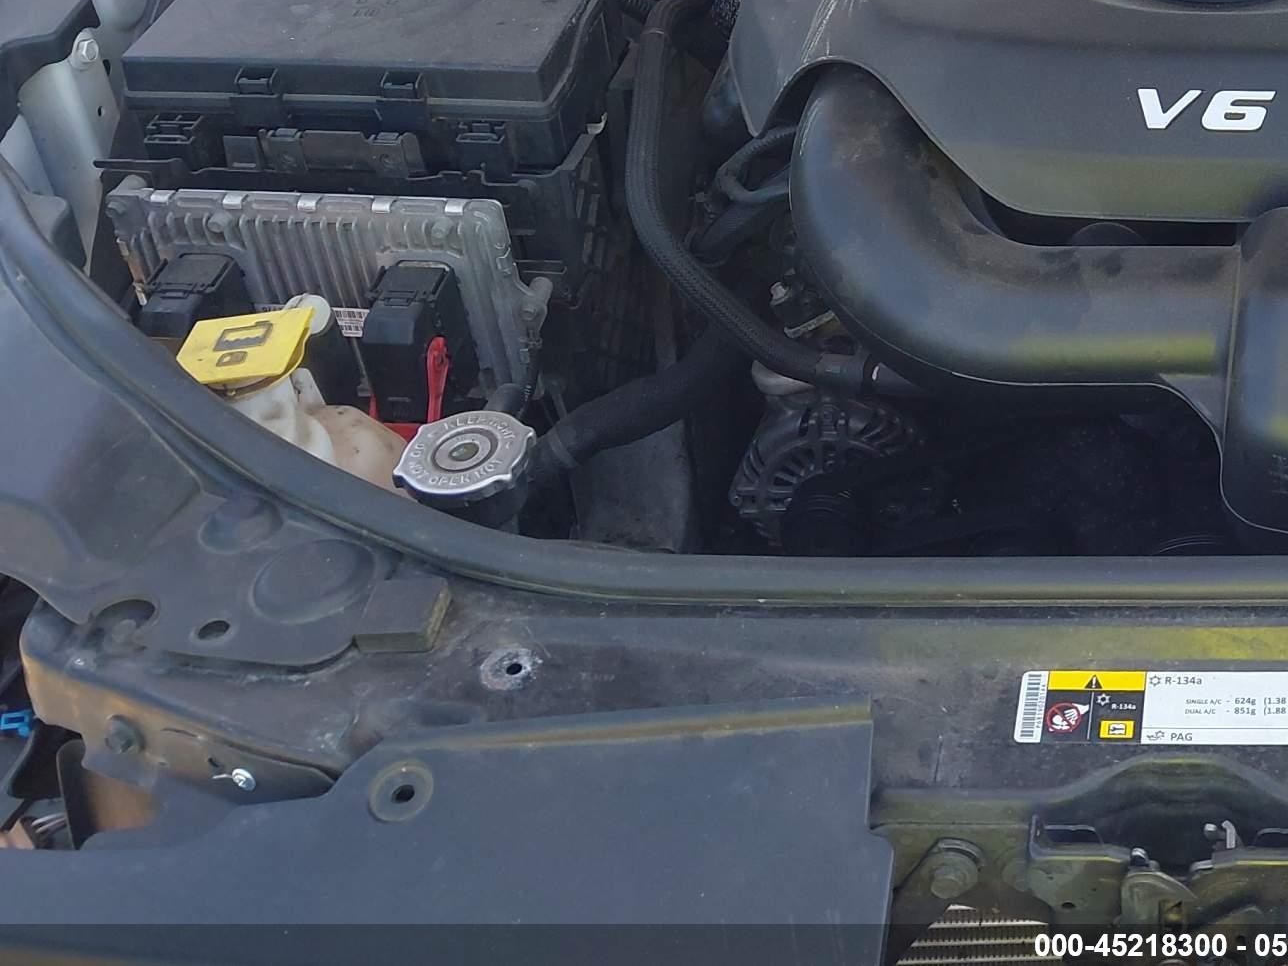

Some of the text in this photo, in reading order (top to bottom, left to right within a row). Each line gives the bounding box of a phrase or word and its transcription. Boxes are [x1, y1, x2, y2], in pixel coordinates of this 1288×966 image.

[1137, 88, 1277, 131] V6
[1164, 675, 1203, 685] R-134a
[1210, 698, 1222, 706] A/C
[1234, 697, 1257, 706] 624g
[1263, 696, 1287, 706] (1.38
[1111, 703, 1137, 711] R-134a
[1233, 706, 1257, 716] 851g
[1263, 706, 1287, 716] (1.88
[1169, 732, 1193, 742] PAG
